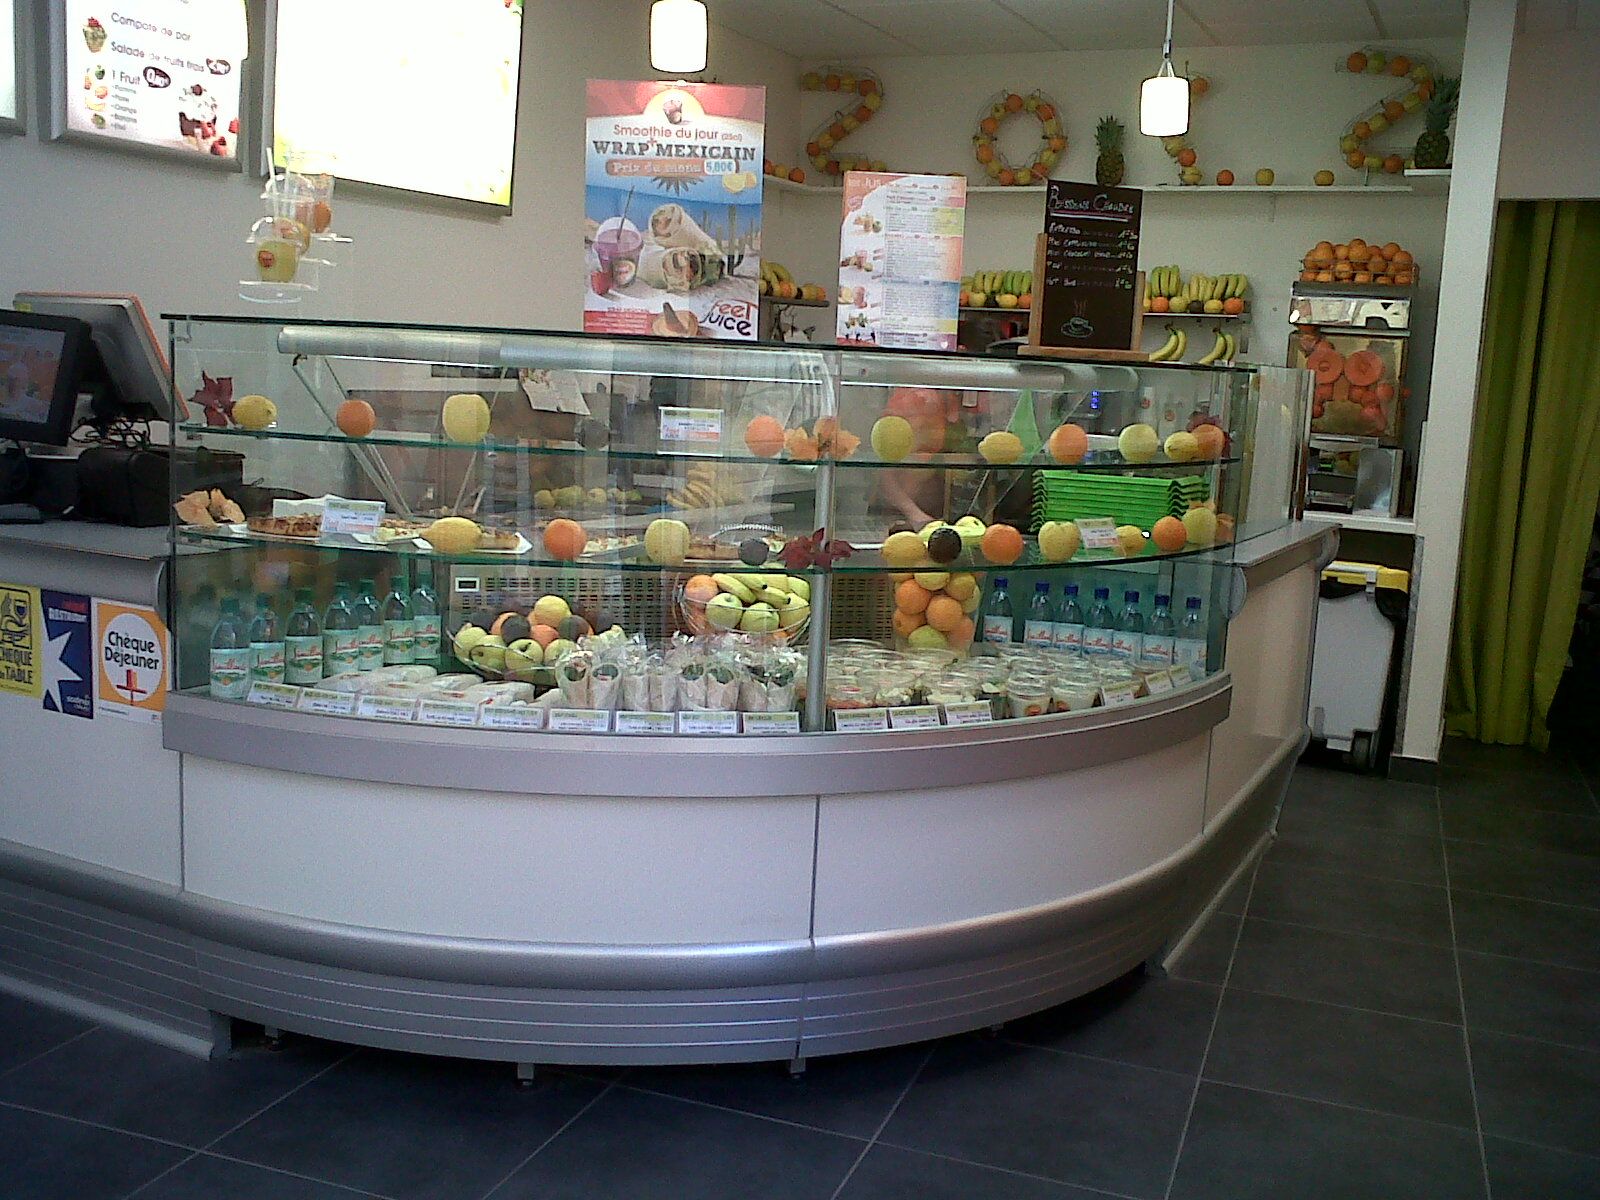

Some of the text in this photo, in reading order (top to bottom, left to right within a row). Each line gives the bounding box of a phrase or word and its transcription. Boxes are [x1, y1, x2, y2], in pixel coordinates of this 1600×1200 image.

[111, 12, 157, 32] Compote
[111, 41, 145, 58] Salade
[119, 71, 141, 85] Fruit
[613, 124, 672, 138] Smoothie
[675, 127, 692, 139] du
[695, 128, 719, 140] jour
[592, 140, 756, 161] WRAP MEXICAIN
[108, 631, 155, 653] Chèque
